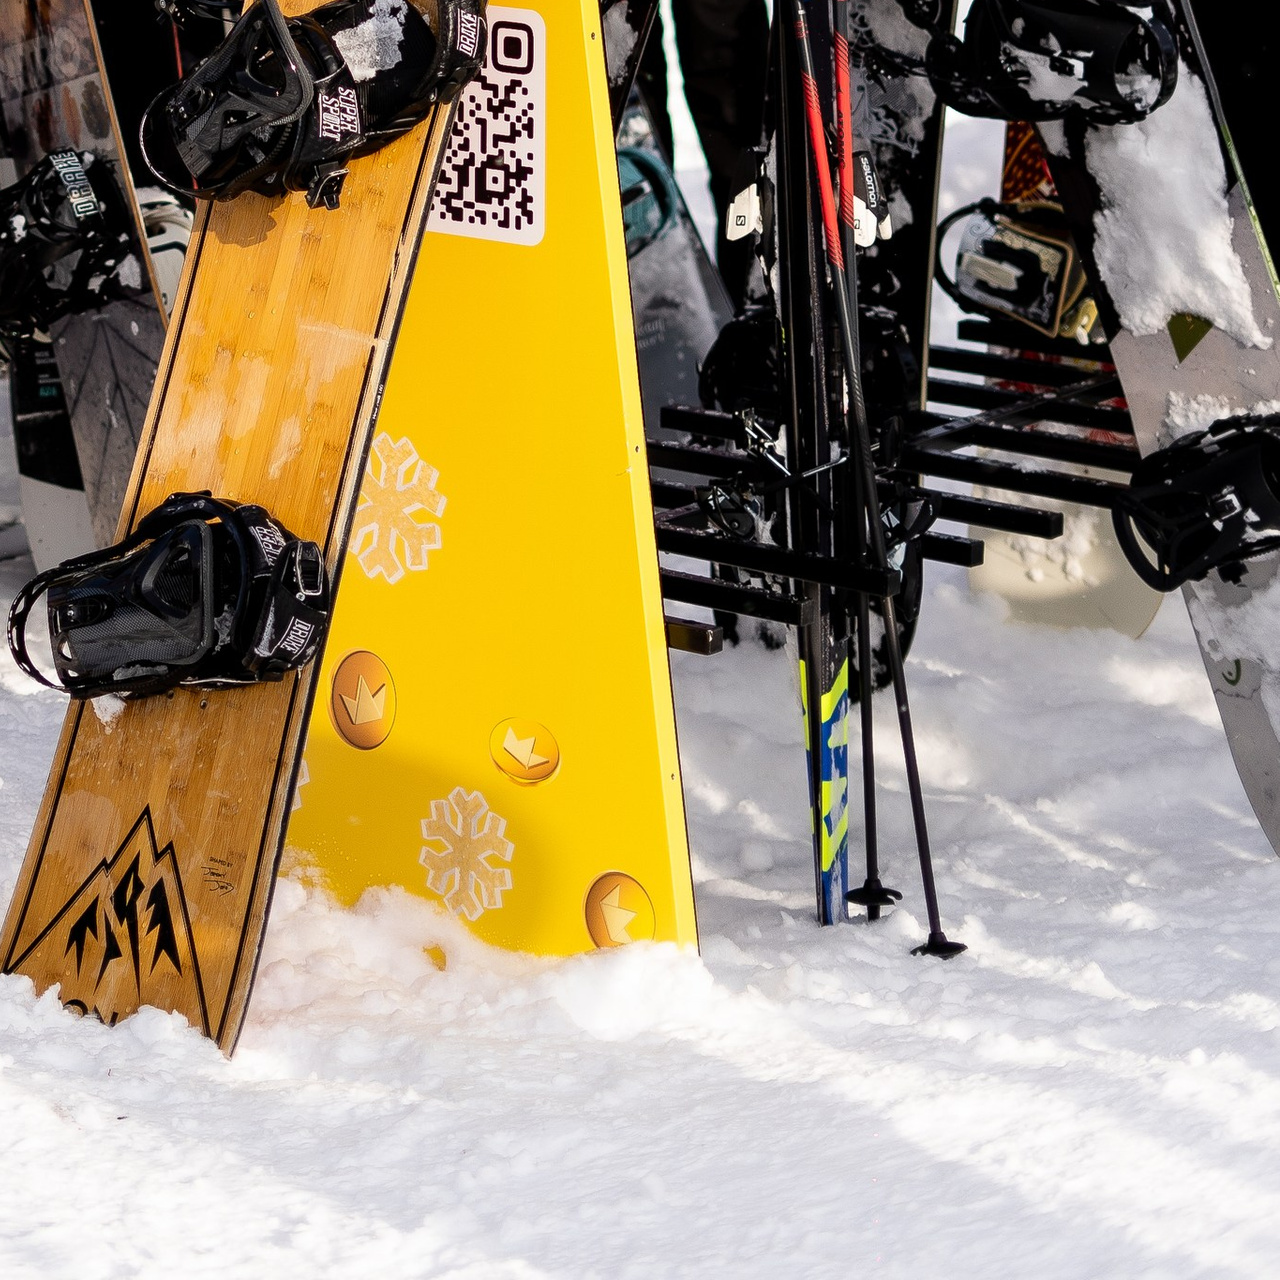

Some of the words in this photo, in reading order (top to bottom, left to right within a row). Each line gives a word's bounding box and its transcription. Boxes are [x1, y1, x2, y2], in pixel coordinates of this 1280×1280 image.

[458, 10, 478, 57] DRAKE
[322, 94, 342, 142] SPORT
[338, 85, 359, 134] SUPER
[49, 151, 100, 218] DRAKE
[280, 618, 312, 654] DRAKE
